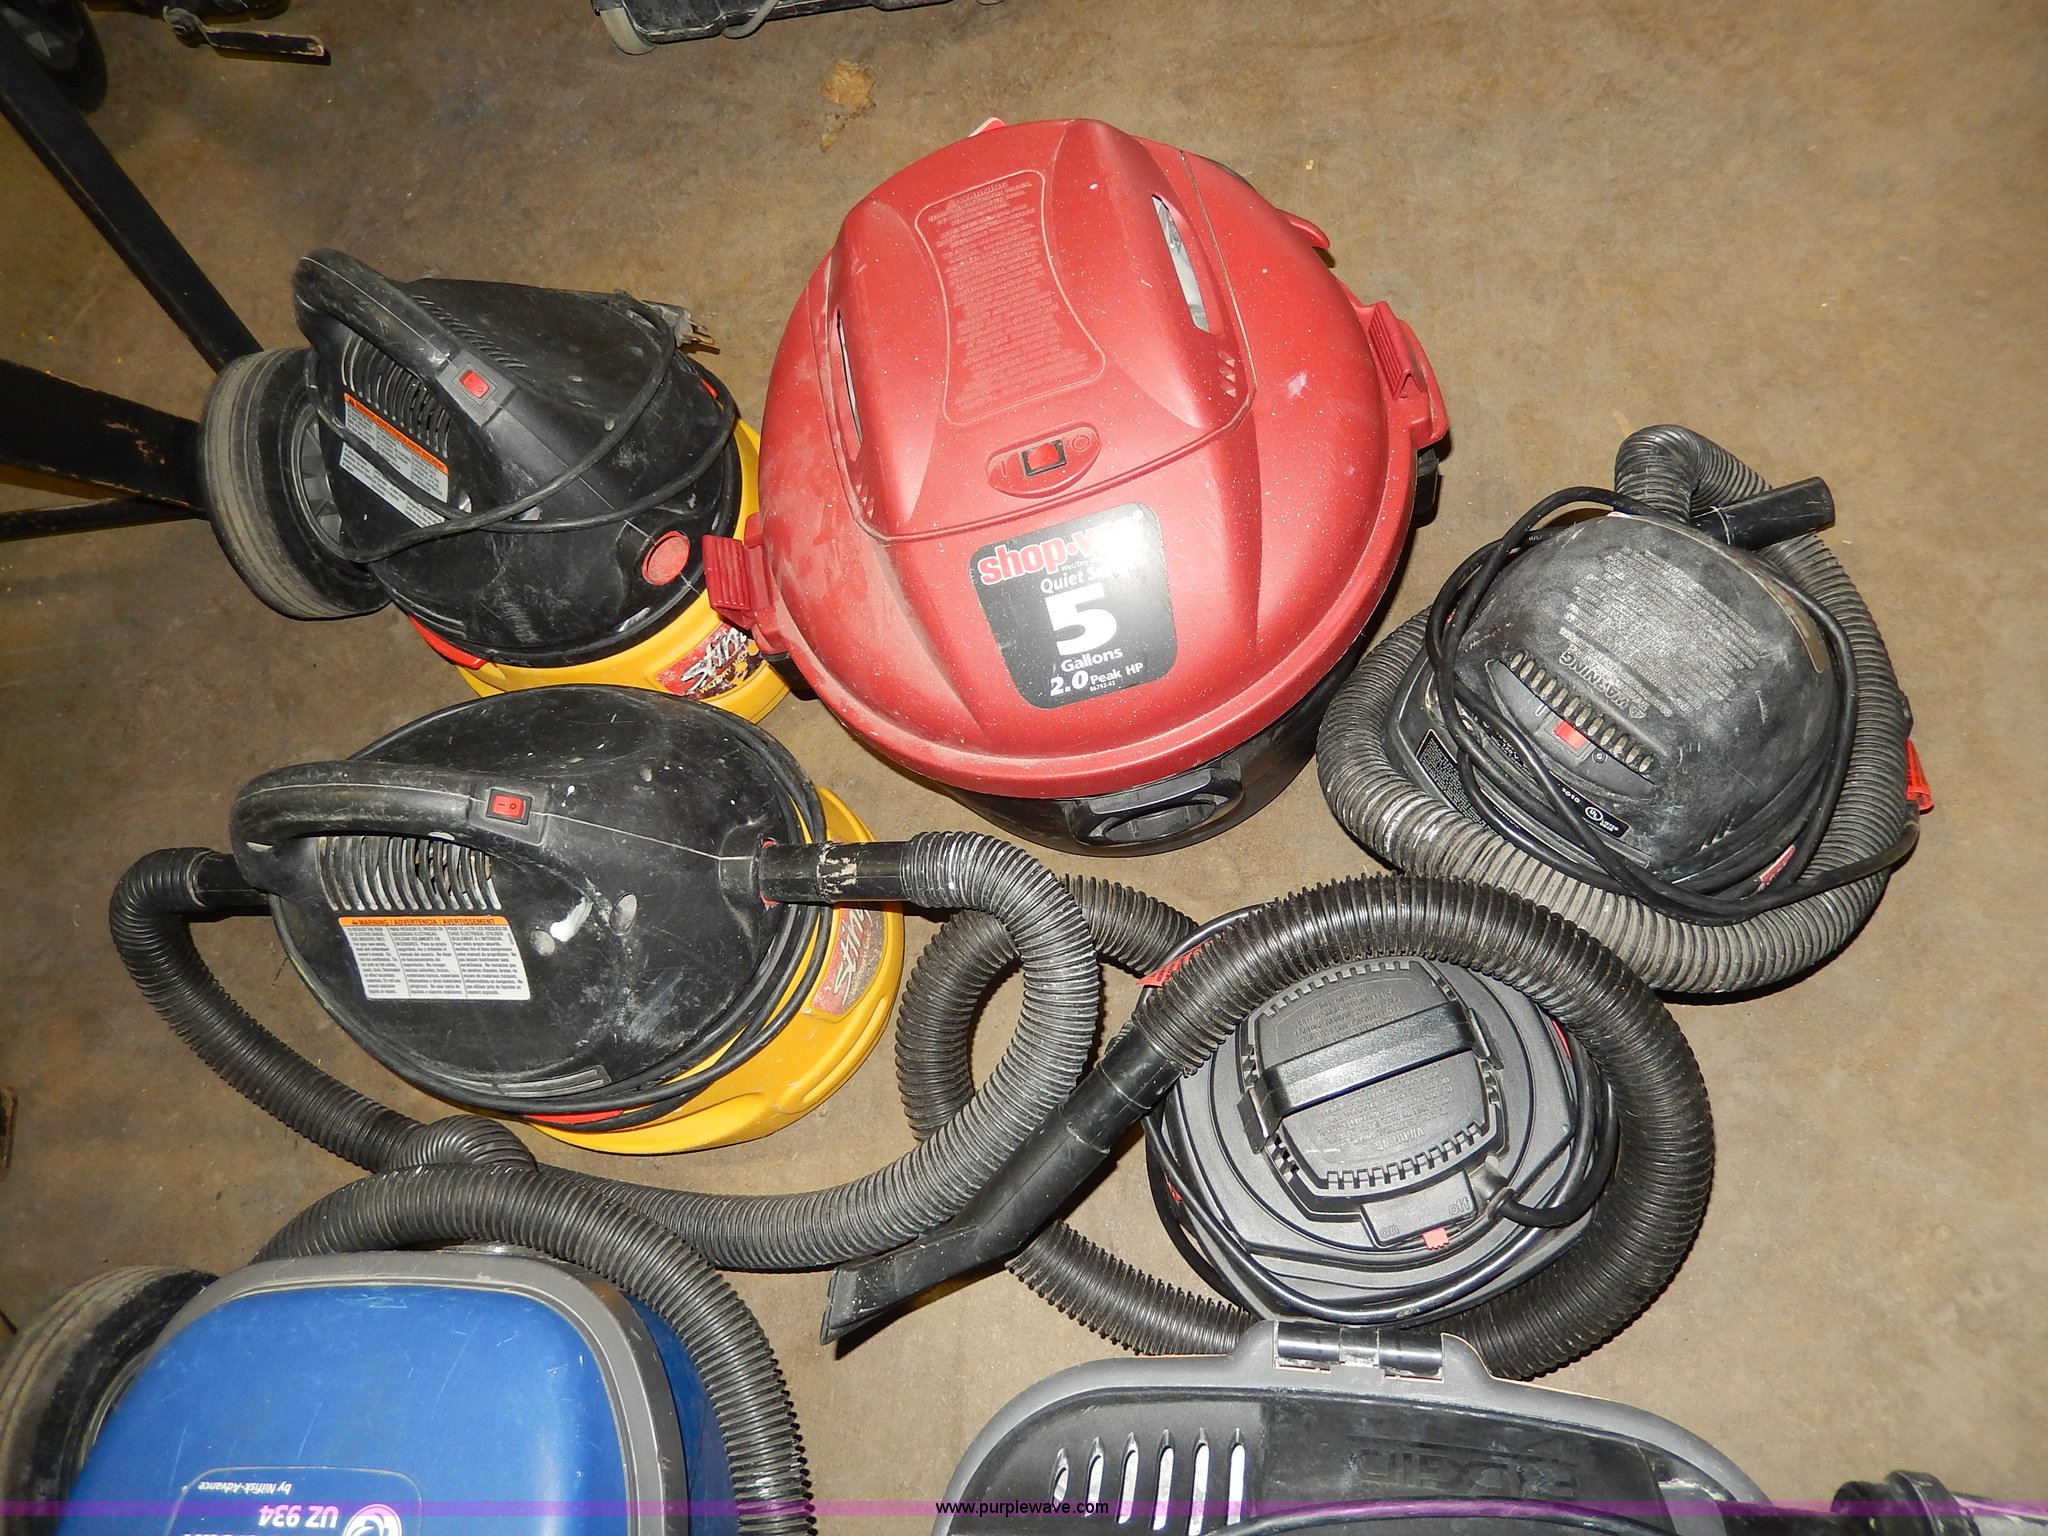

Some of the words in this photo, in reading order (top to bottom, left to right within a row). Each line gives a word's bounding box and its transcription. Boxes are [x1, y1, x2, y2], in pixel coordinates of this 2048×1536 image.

[1040, 570, 1084, 594] Quiet
[1045, 582, 1117, 656] 5
[1061, 647, 1123, 672] Gallons
[1050, 670, 1089, 696] 2.0
[1090, 668, 1122, 685] Peak
[1125, 662, 1144, 676] HP
[1557, 649, 1633, 711] WARNING
[1449, 1196, 1470, 1215] off
[1379, 1223, 1400, 1239] on
[198, 1481, 276, 1495] Nilfisk-Advance
[278, 1482, 292, 1495] by
[258, 1504, 302, 1528] 934
[306, 1505, 339, 1529] UZ
